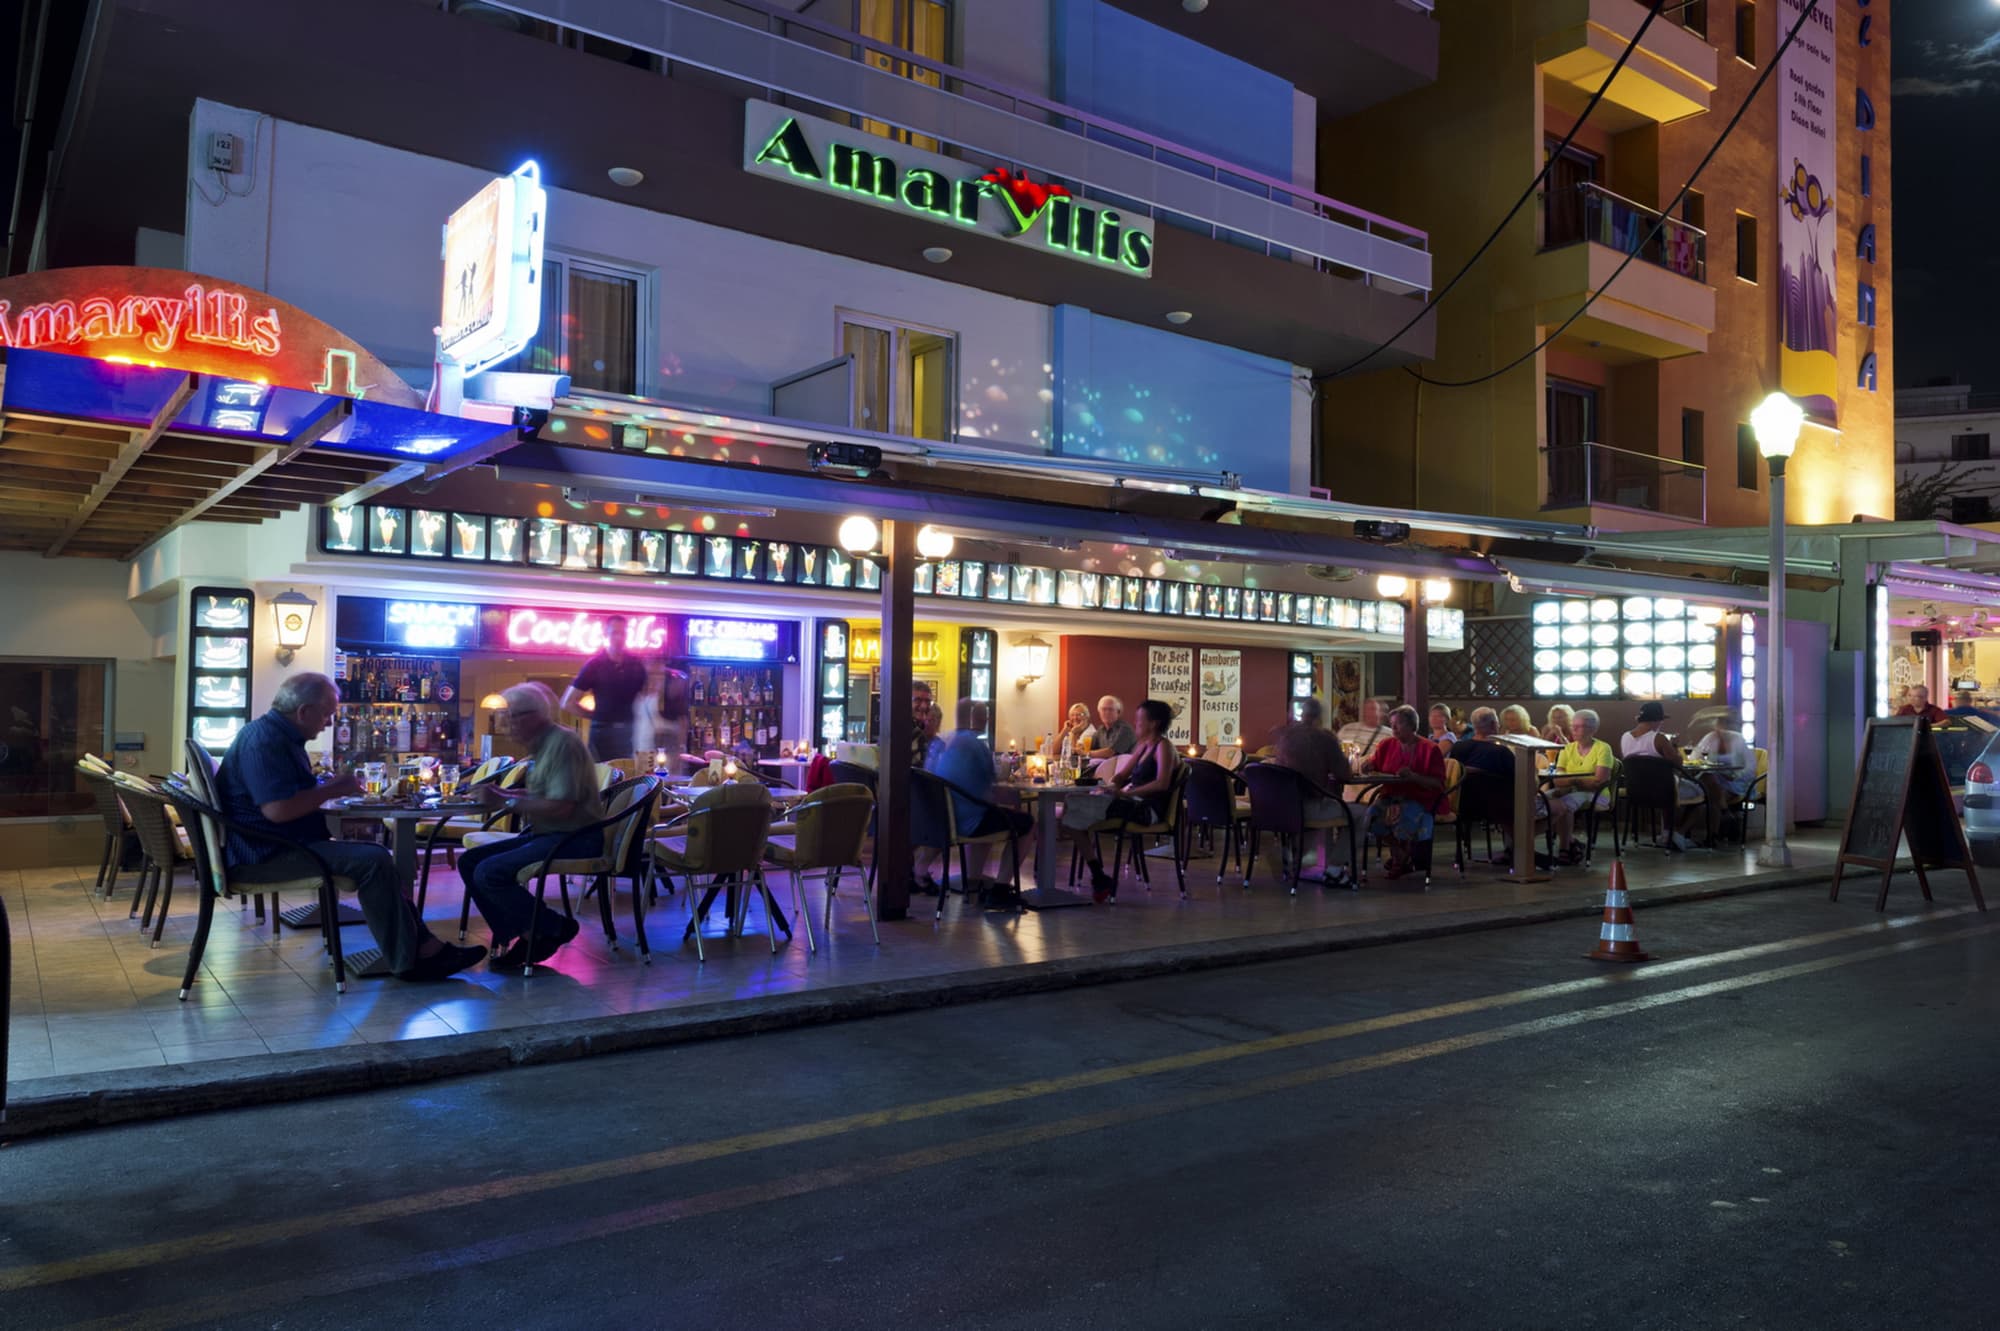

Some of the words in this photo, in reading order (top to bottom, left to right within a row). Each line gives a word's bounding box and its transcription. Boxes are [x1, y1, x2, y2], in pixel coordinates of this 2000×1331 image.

[755, 117, 1153, 273] Amaryllis
[1855, 86, 1877, 392] DIANA
[388, 602, 476, 626] SNACK
[508, 609, 666, 654] Cocktils
[1153, 651, 1166, 663] The
[1169, 651, 1190, 663] Best
[1151, 663, 1190, 676] ENGLISH
[1150, 677, 1191, 693] Breakfast
[1202, 699, 1239, 712] TOASTIES
